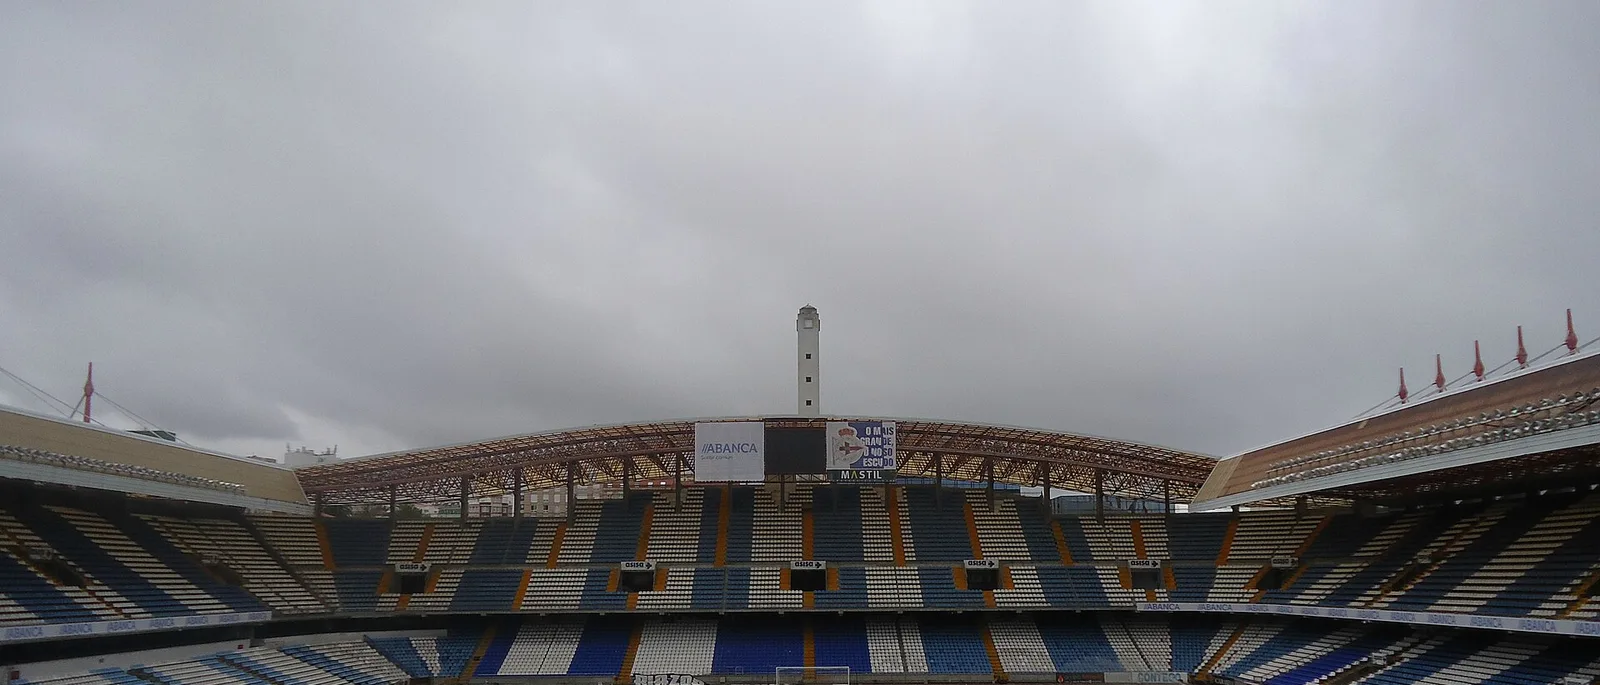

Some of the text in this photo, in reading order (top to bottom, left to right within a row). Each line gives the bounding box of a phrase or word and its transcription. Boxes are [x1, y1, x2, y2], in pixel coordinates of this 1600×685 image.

[865, 426, 894, 436] O MAIS
[863, 458, 894, 467] ESCUDO
